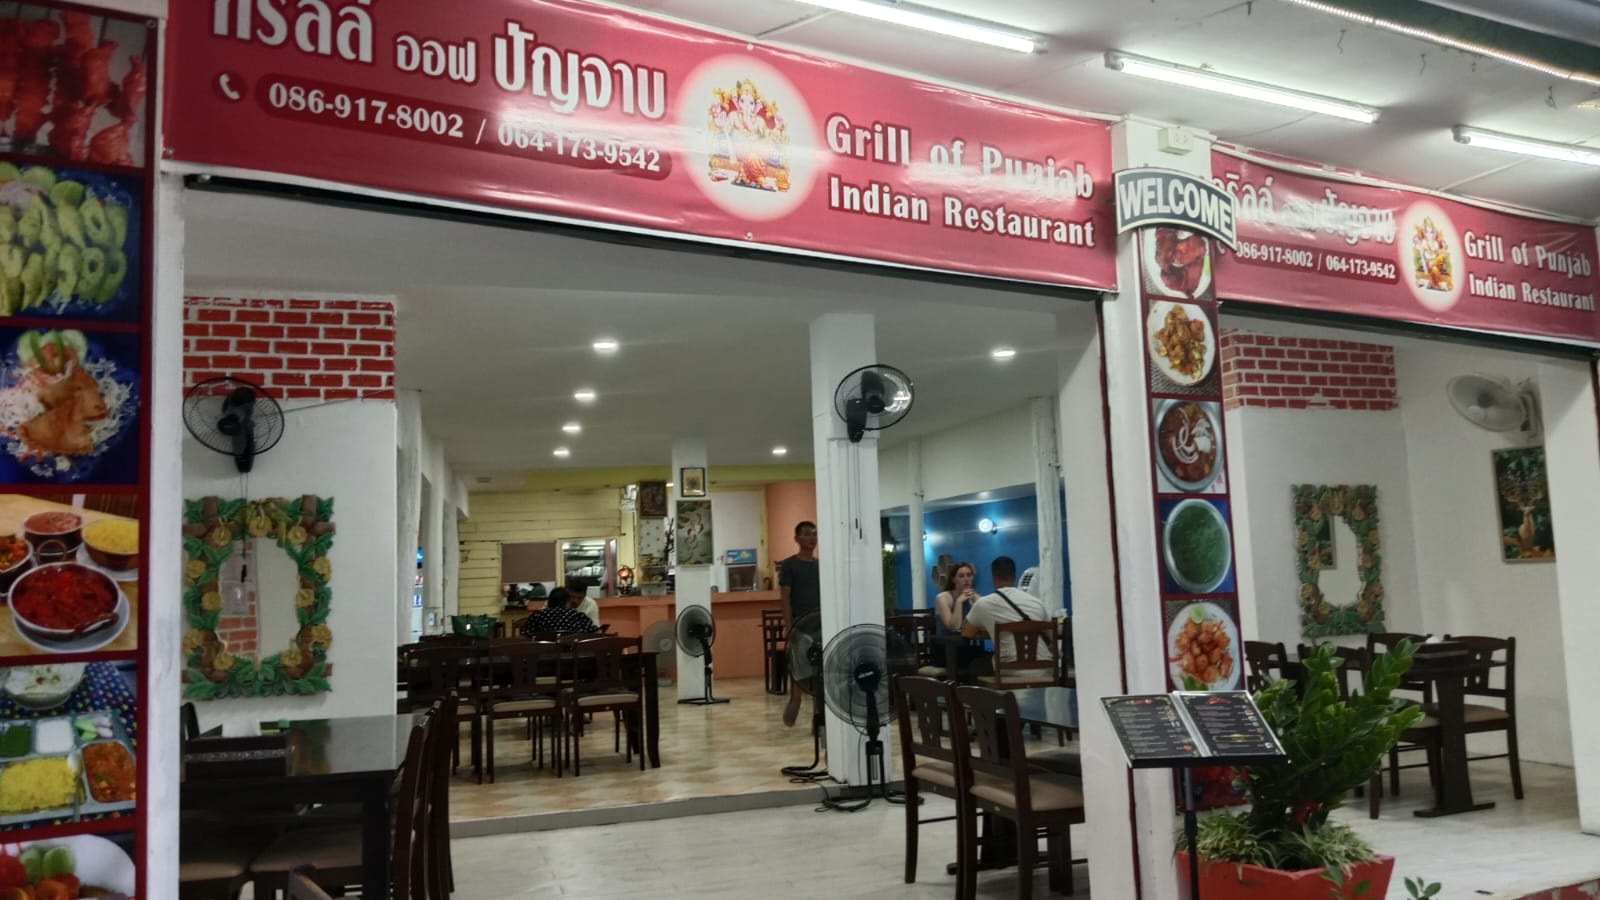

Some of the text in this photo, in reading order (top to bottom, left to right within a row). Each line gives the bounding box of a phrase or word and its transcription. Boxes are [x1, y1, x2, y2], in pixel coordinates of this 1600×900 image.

[395, 34, 477, 83] ออฟ
[494, 21, 665, 120] ปัญจาบ
[268, 82, 661, 173] 086-917-8002 / 064-173-9542
[826, 115, 1094, 199] Grill of Punjab
[829, 176, 1096, 247] Indian Restaurant
[1119, 177, 1233, 239] WELCOME
[1326, 254, 1396, 280] 064-173-9542
[1464, 231, 1591, 279] Grill of Punjab
[1468, 273, 1596, 316] Indian Restaurant
